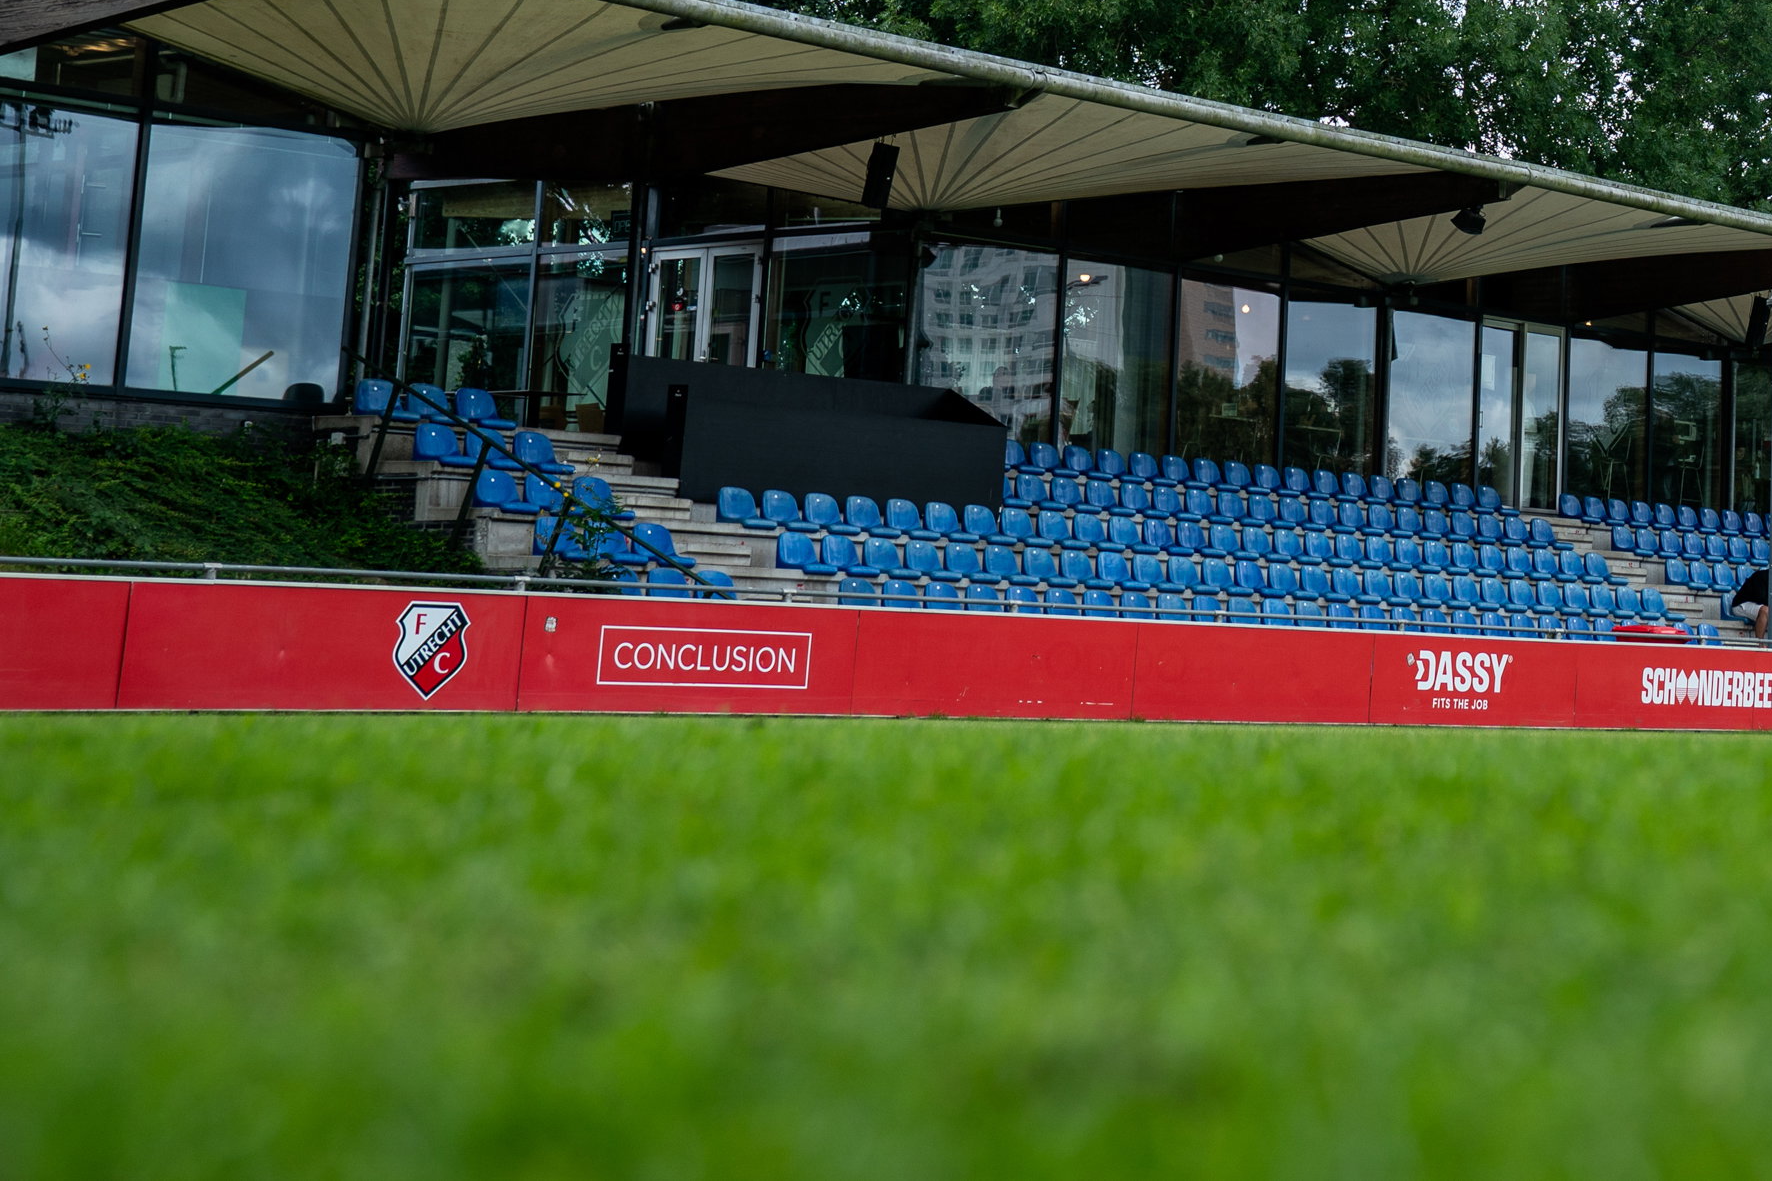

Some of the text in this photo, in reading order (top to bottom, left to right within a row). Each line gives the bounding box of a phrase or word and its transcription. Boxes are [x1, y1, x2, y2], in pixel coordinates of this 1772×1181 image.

[414, 613, 427, 635] F
[402, 611, 462, 676] UTRECHT
[433, 652, 451, 674] C
[613, 642, 796, 673] CONCLUSION
[1432, 697, 1488, 710] FITS THE JOB
